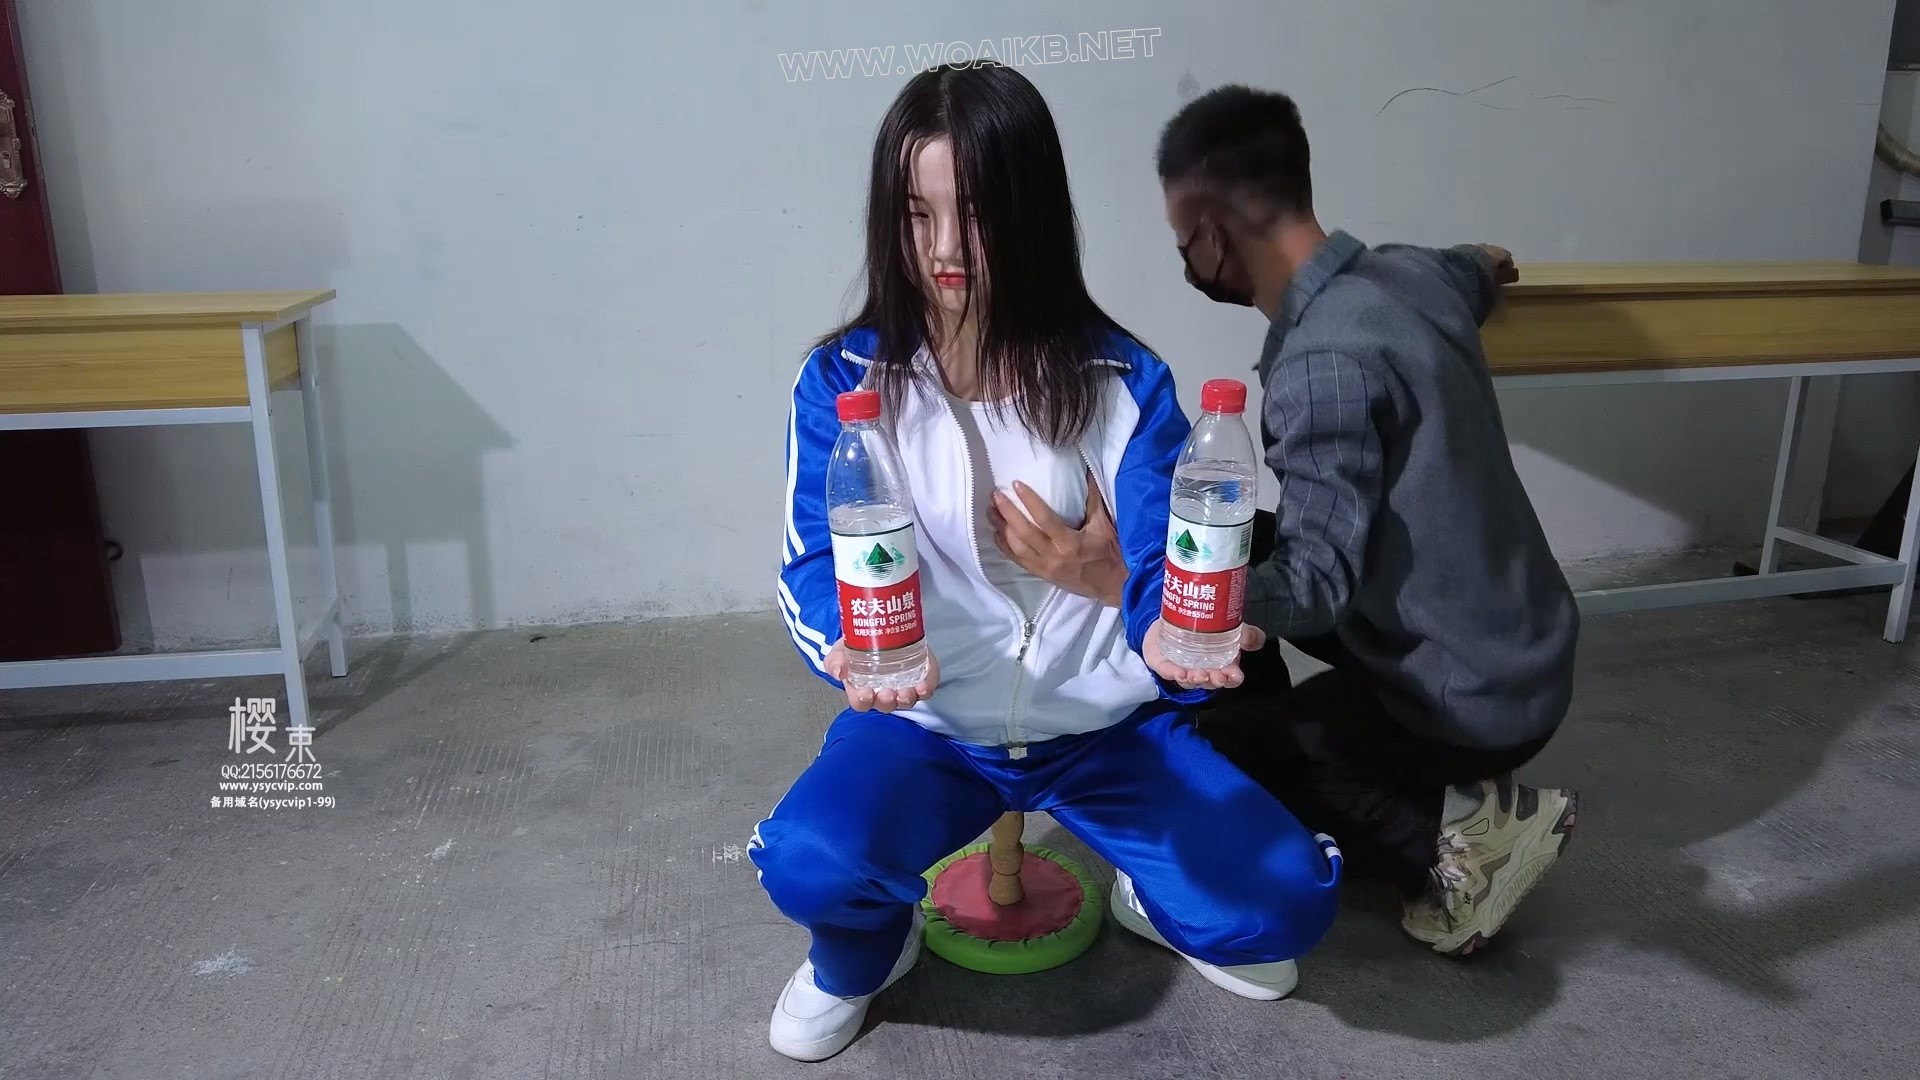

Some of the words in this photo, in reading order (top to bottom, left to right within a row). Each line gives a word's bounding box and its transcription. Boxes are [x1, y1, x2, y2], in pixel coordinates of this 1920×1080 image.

[850, 591, 916, 617] 农夫山泉
[1182, 598, 1215, 611] SPRING
[853, 617, 886, 627] NONGFU
[888, 609, 917, 625] SPRING
